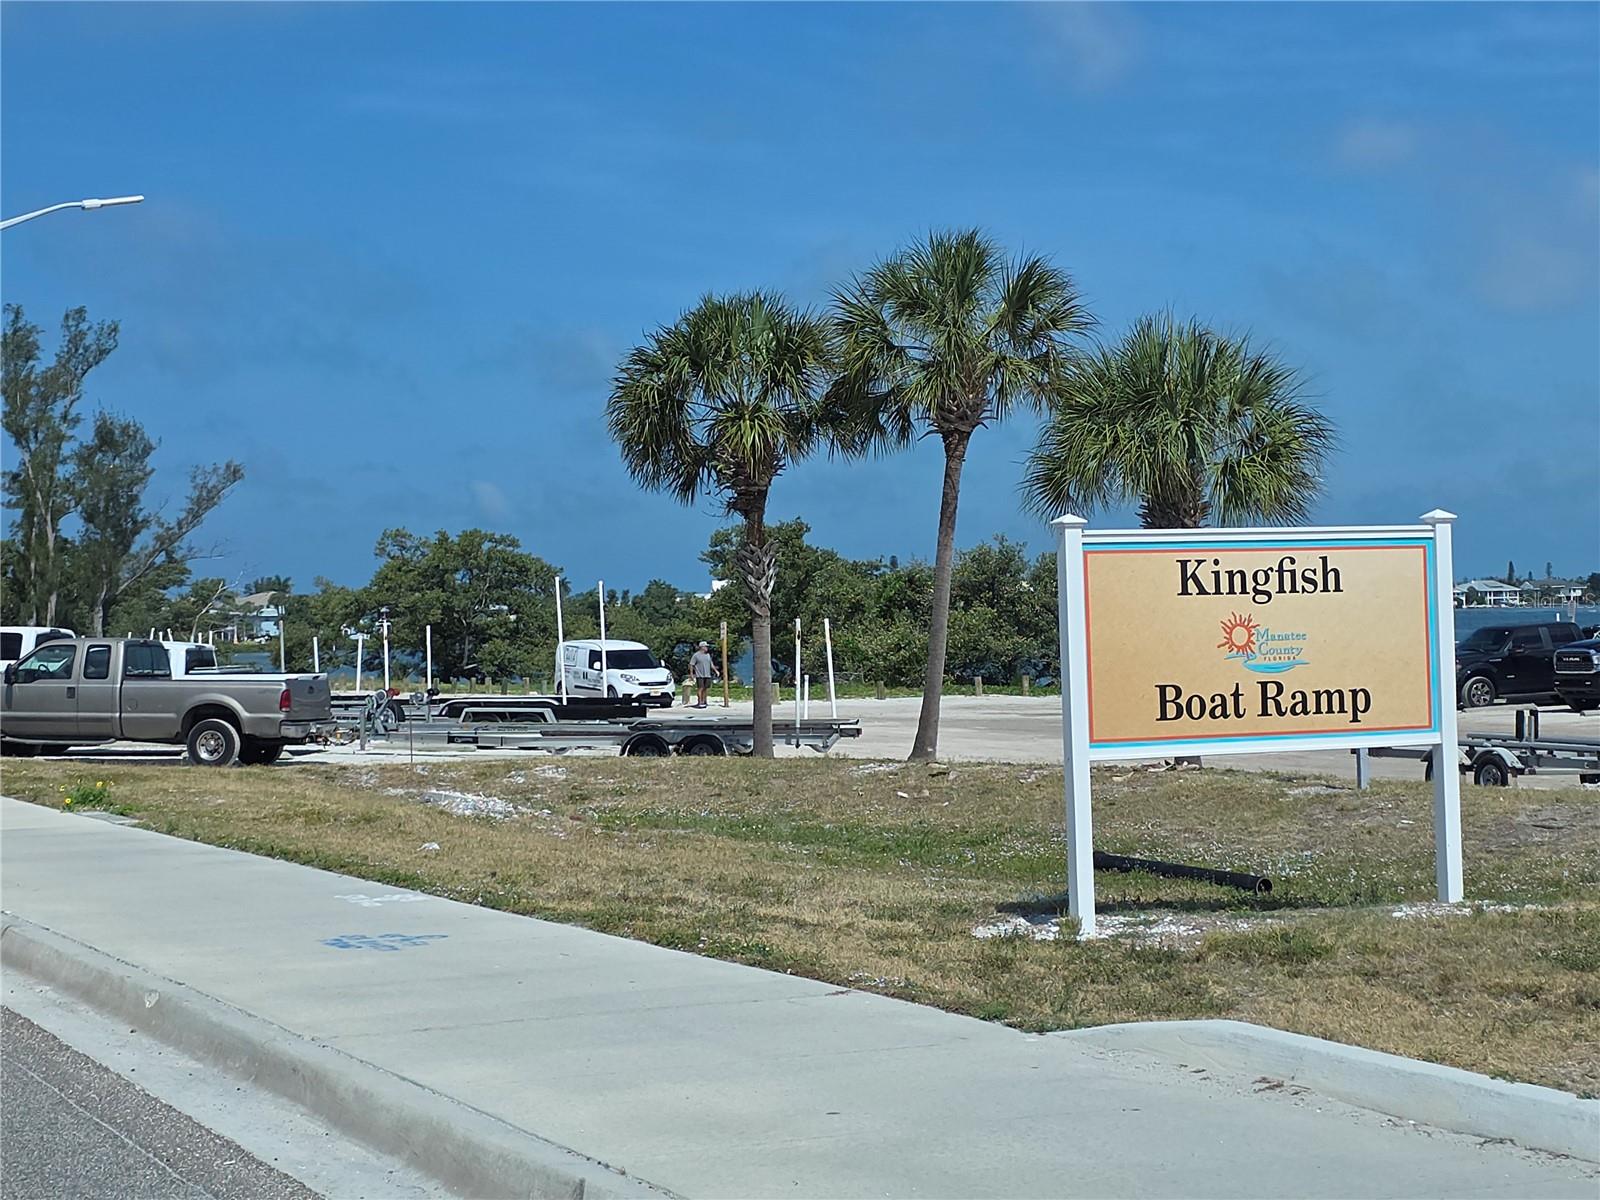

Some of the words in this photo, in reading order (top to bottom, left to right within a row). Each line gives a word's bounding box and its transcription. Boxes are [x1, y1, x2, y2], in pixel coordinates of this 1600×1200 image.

[1176, 556, 1343, 604] Kingfish
[1255, 628, 1307, 641] Manatee
[1258, 642, 1303, 656] County
[1155, 682, 1246, 721] Boat
[1257, 680, 1371, 723] Ramp
